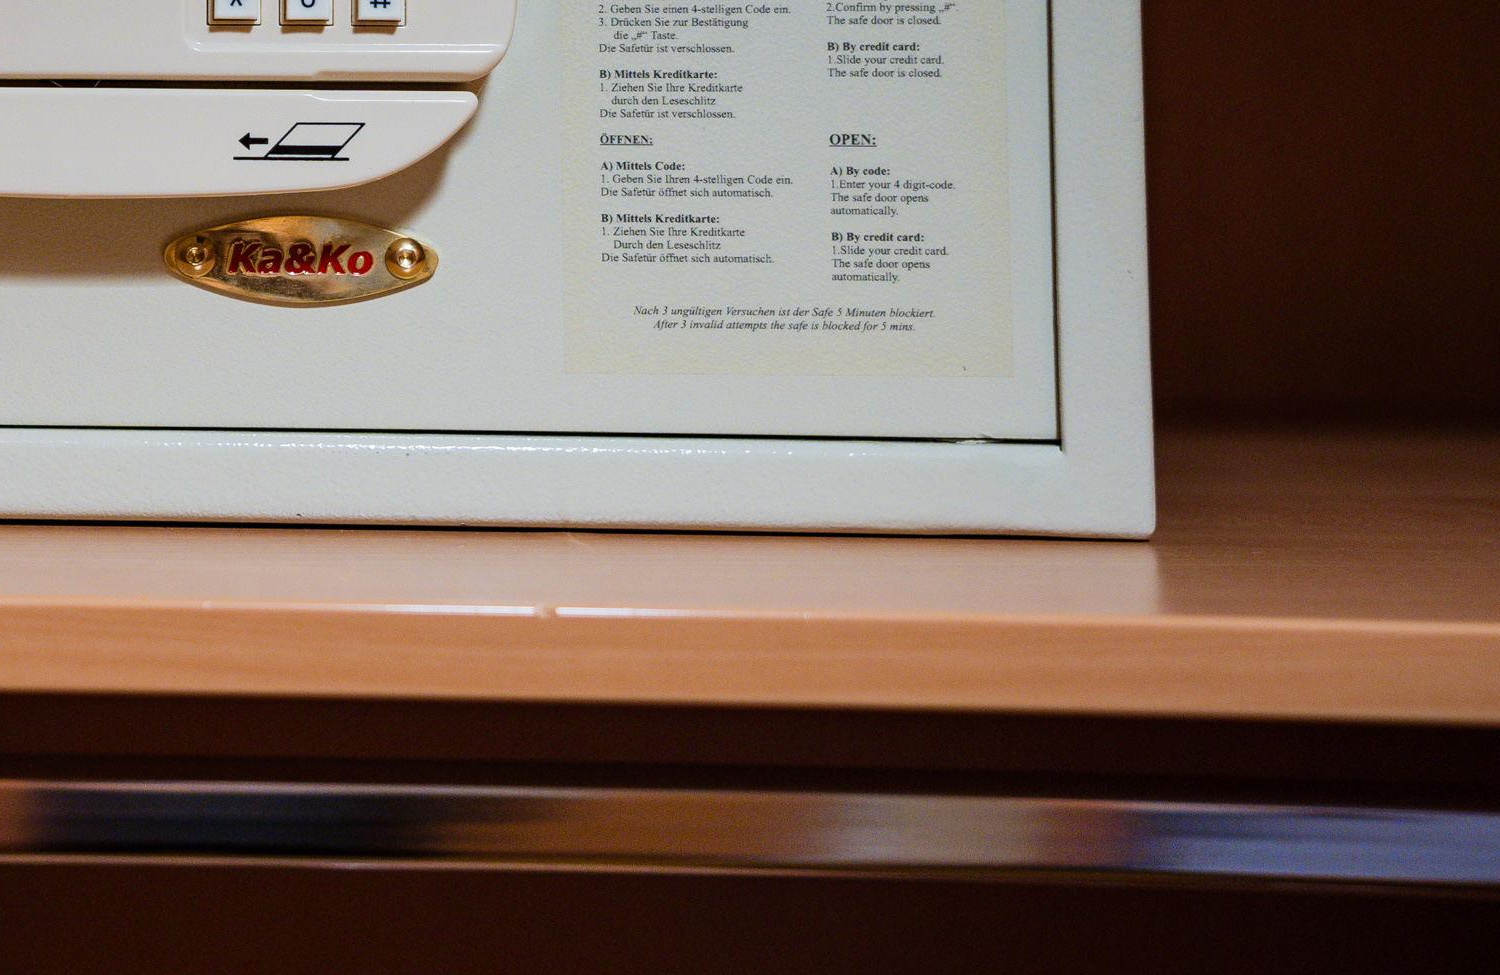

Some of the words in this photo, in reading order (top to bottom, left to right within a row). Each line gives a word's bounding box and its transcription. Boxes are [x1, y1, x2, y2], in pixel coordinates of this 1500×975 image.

[610, 4, 642, 14] Geben
[644, 4, 660, 14] Sie
[662, 4, 689, 14] einen
[691, 4, 743, 16] 4-stelligen
[744, 4, 771, 14] Code
[773, 5, 791, 14] ein.
[879, 2, 892, 14] by
[894, 3, 936, 14] pressing
[610, 17, 652, 27] Drücken
[654, 17, 670, 27] Sie
[691, 17, 749, 30] Bestätigung
[826, 15, 846, 25] The
[848, 14, 868, 25] safe
[870, 15, 894, 25] door
[896, 16, 905, 25] is
[907, 15, 941, 26] closed.
[599, 43, 616, 53] Die
[619, 43, 654, 53] Safetür
[656, 44, 668, 53] ist
[670, 44, 734, 54] verschlossen.
[827, 42, 840, 52] B)
[842, 42, 856, 53] By
[859, 42, 890, 51] credit
[892, 42, 920, 52] card:
[864, 57, 887, 66] your
[889, 55, 918, 64] credit
[920, 55, 944, 65] card.
[599, 69, 612, 80] B)
[614, 70, 650, 79] Mittels
[653, 70, 718, 79] Kreditkarte:
[611, 82, 645, 92] Ziehen
[647, 82, 663, 92] Sie
[666, 82, 685, 92] Ihre
[688, 83, 743, 92] Kreditkarte
[600, 132, 653, 146] ÖFFNEN:
[829, 134, 877, 148] OPEN:
[600, 162, 613, 172] A)
[616, 161, 652, 170] Mittels
[654, 161, 685, 171] Code:
[830, 166, 843, 176] A)
[846, 166, 860, 178] By
[862, 166, 890, 176] code:
[600, 186, 618, 197] Die
[621, 186, 656, 197] Safetür
[658, 187, 687, 197] öffnet
[690, 188, 710, 197] sich
[712, 188, 773, 198] automatisch.
[868, 182, 891, 192] your
[894, 180, 900, 189] 4
[902, 180, 955, 192] digit-code.
[830, 192, 850, 202] The
[852, 192, 872, 202] safe
[874, 192, 898, 202] door
[900, 195, 929, 205] opens
[830, 206, 898, 218] automatically.
[601, 214, 613, 224] B)
[616, 214, 652, 223] Mittels
[655, 214, 720, 224] Kreditkarte:
[831, 232, 844, 242] B)
[846, 232, 860, 244] By
[863, 232, 894, 242] credit
[896, 233, 924, 242] card:
[227, 241, 374, 275] Ka&Ko
[634, 306, 659, 315] Nach
[662, 306, 668, 316] 3
[670, 306, 722, 318] ungültigen
[726, 306, 776, 316] Versuchen
[778, 306, 790, 316] ist
[792, 307, 810, 317] der
[812, 307, 834, 319] Safe
[836, 307, 842, 317] 5
[845, 308, 886, 318] Minuten
[889, 308, 934, 318] blockiert.
[653, 319, 678, 330] After
[680, 319, 687, 329] 3
[689, 320, 724, 329] invalid
[726, 322, 768, 332] attempts
[770, 320, 786, 330] the
[788, 320, 808, 332] safe
[811, 320, 819, 330] is
[822, 320, 862, 331] blocked
[861, 321, 878, 332] for
[880, 321, 887, 331] 5
